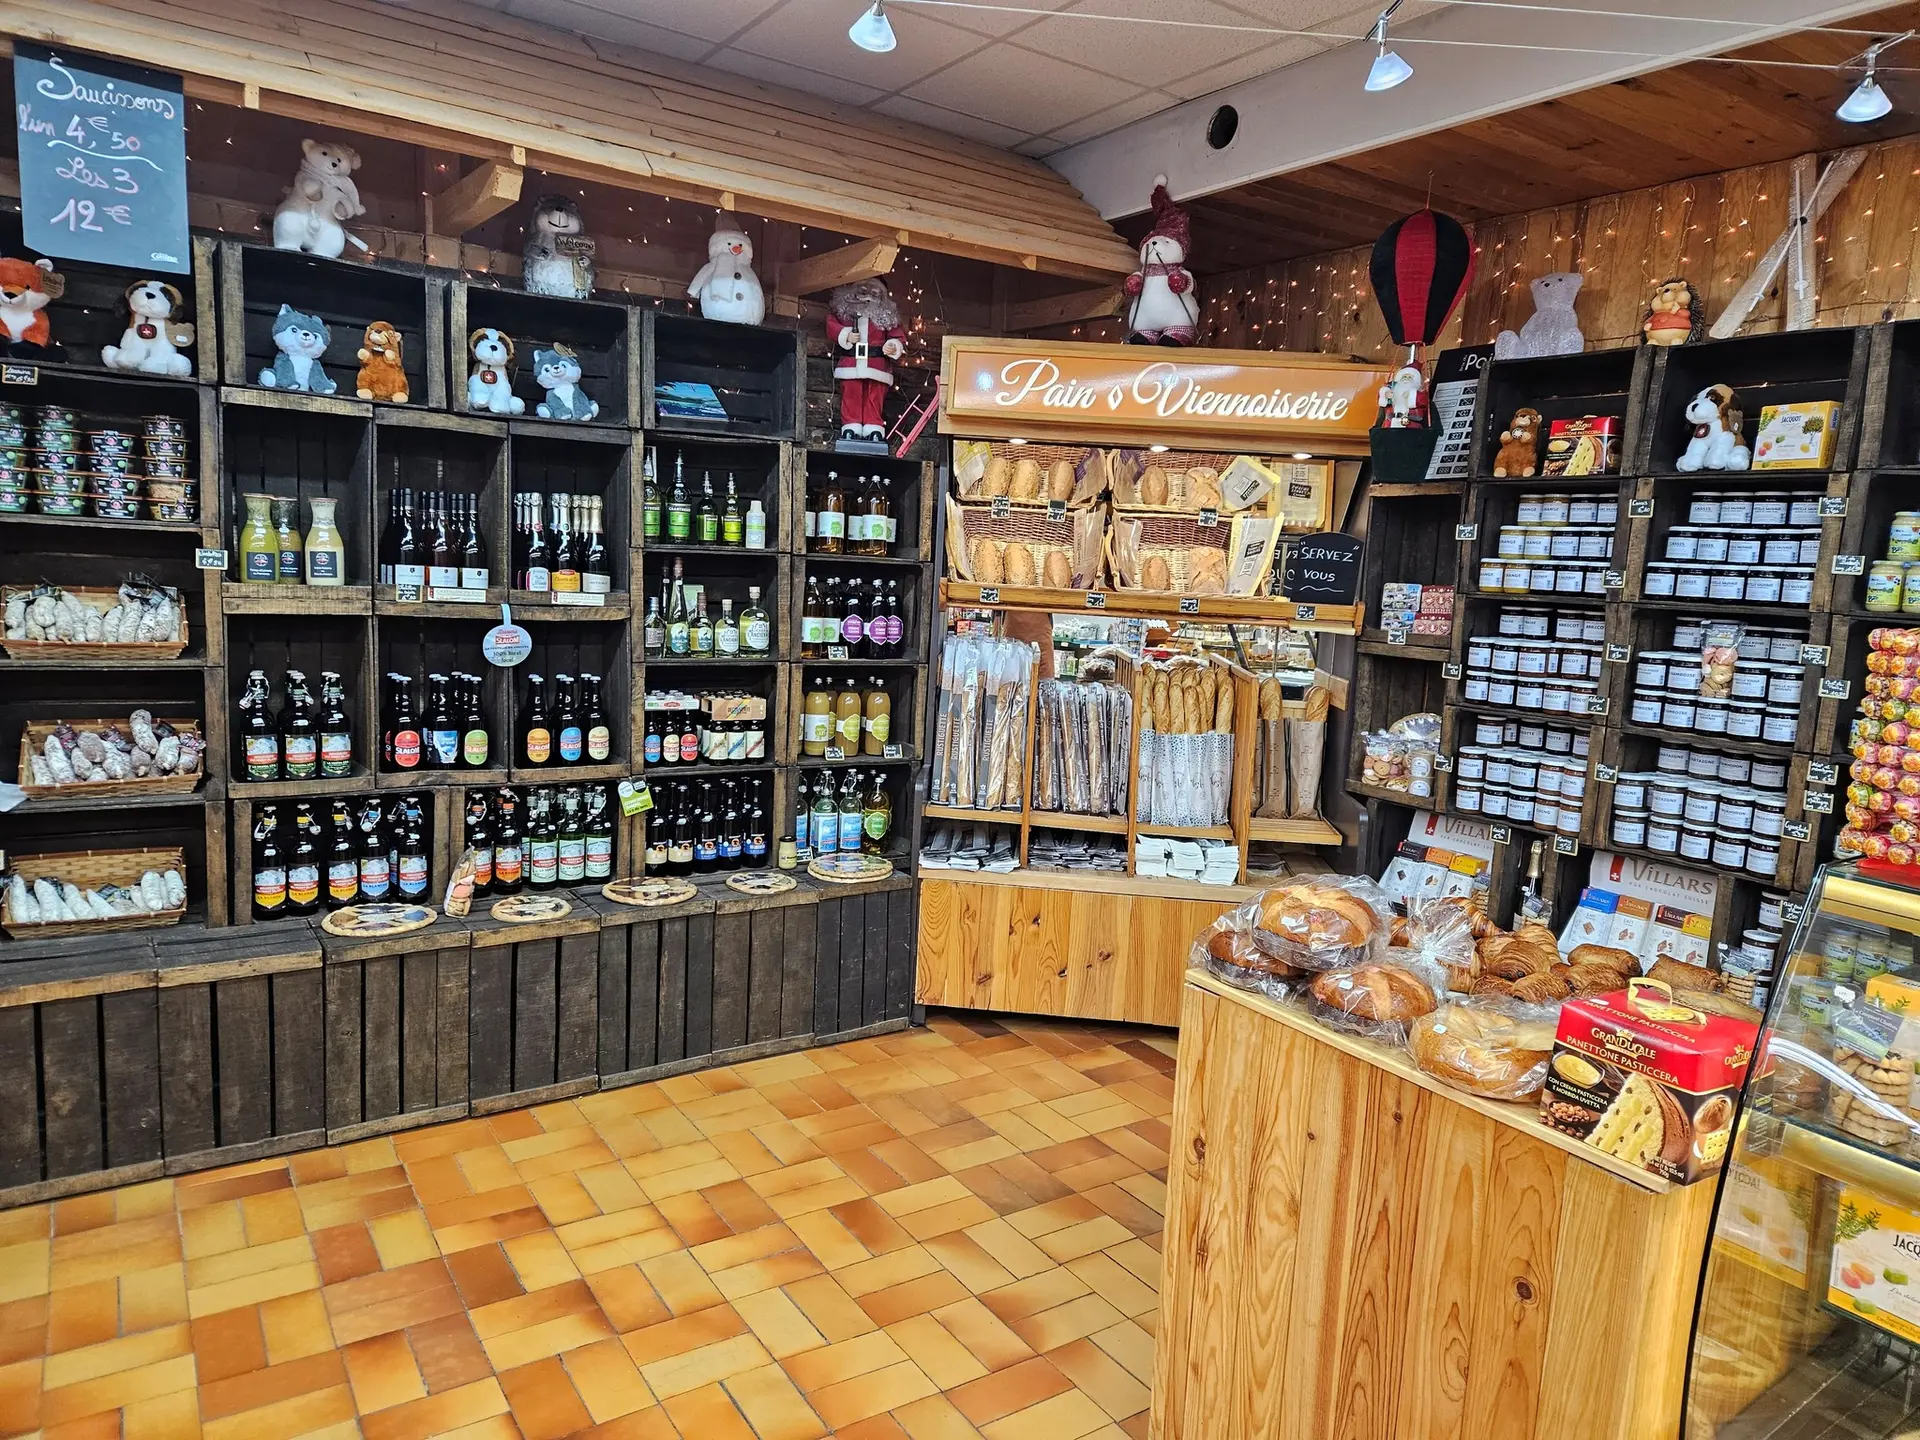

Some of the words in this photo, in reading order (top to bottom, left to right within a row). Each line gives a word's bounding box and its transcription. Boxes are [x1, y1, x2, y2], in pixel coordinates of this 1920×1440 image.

[36, 53, 175, 120] Saucissons
[55, 156, 109, 190] Les
[114, 167, 138, 194] 3
[50, 198, 103, 232] 12
[995, 358, 1098, 407] Pain
[1132, 362, 1348, 421] Viennoiserie
[1781, 415, 1801, 423] JACQUOT
[1303, 569, 1336, 582] VOUS
[395, 746, 420, 754] SLALOM
[936, 713, 947, 756] RUSTIGUETTE
[951, 717, 960, 760] RUSTIGUETTE
[982, 719, 993, 761] RUSTIGUETTE
[1645, 886, 1680, 899] CHOCOLAT
[1684, 895, 1708, 905] SUISSE
[1583, 1000, 1638, 1022] PANETTONE
[1639, 1018, 1695, 1043] PASTICCERA
[1566, 1035, 1619, 1062] PANETTONE
[1621, 1055, 1679, 1085] PASTICCERA
[1548, 1076, 1559, 1086] CON
[1559, 1081, 1577, 1093] CREMA
[1577, 1089, 1608, 1106] PASTICCERA
[1556, 1087, 1579, 1100] MORBIDA
[1580, 1097, 1600, 1109] UVETTA
